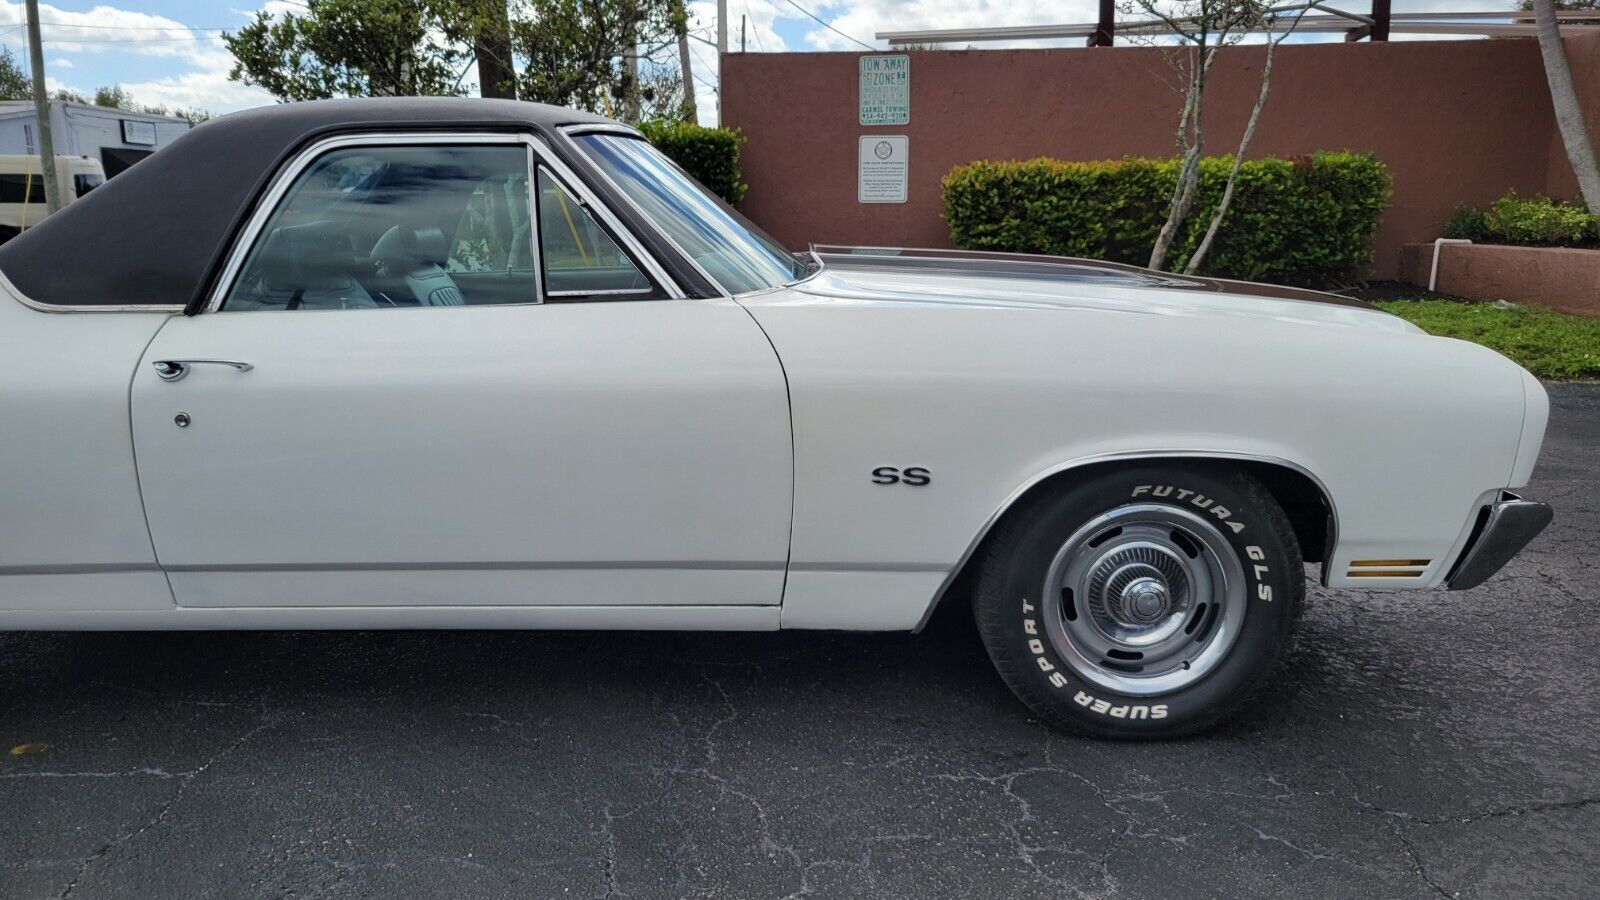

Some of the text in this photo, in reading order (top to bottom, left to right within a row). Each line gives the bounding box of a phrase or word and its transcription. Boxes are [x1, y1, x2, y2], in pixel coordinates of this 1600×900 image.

[863, 58, 906, 71] TOW AWAY
[873, 72, 896, 85] ZONE
[872, 466, 931, 486] SS
[1131, 484, 1273, 603] FUTURA GLS
[1022, 598, 1169, 720] SUPER SPORT
